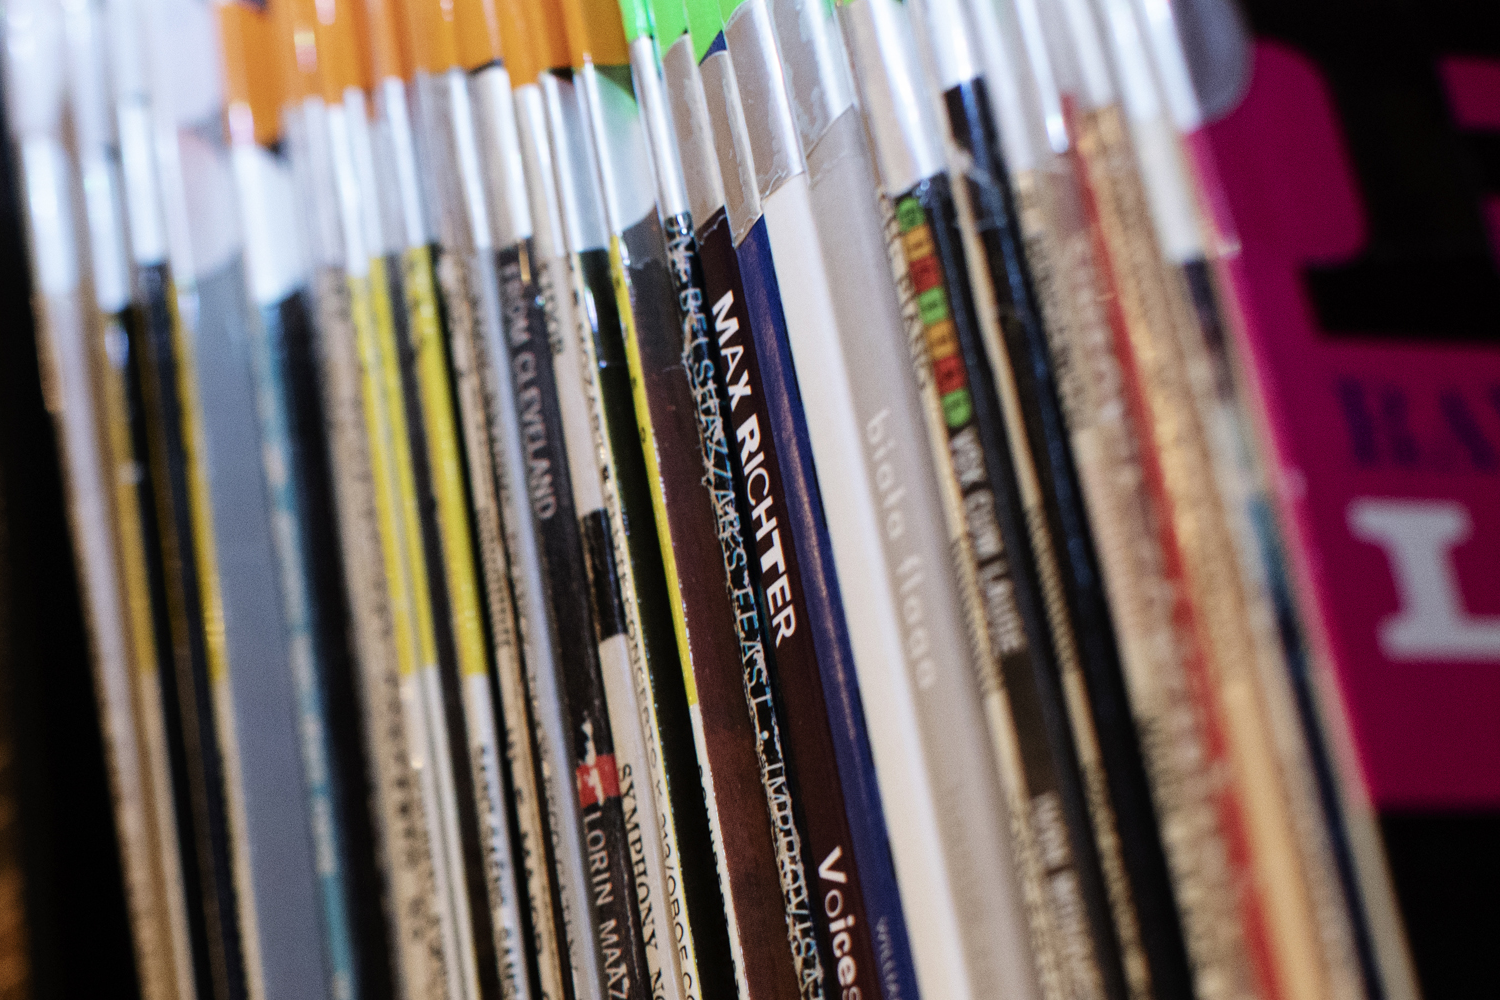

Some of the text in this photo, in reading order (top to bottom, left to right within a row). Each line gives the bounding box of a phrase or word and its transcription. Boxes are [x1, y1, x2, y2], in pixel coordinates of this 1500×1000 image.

[512, 349, 559, 522] CLEVELAND
[709, 288, 754, 412] MAX
[733, 412, 799, 649] RICHTER
[731, 584, 775, 712] FEAST
[582, 810, 613, 907] LORIN
[616, 762, 659, 953] SYMPHONY
